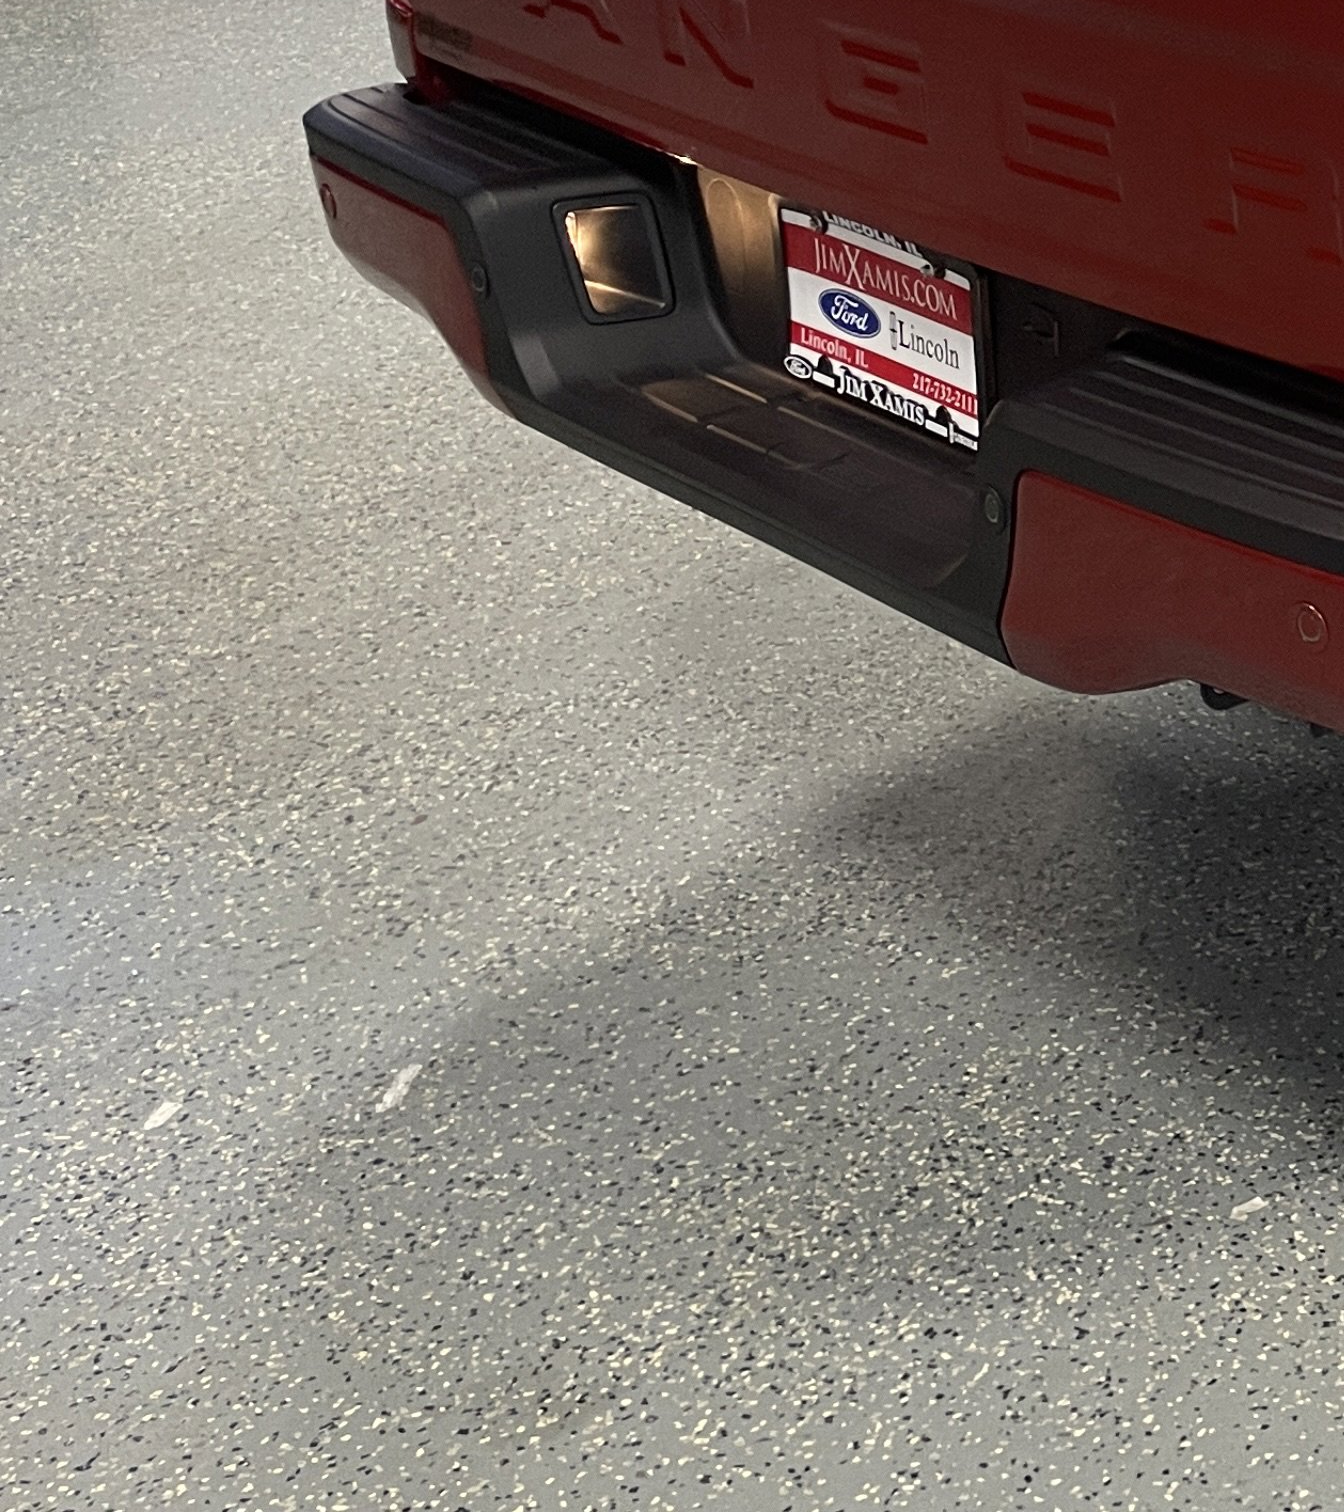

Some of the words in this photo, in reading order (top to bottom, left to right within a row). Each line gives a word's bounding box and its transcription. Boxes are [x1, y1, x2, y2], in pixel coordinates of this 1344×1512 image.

[814, 237, 958, 321] JIMXAMIS.COM
[830, 294, 869, 332] Ford
[854, 351, 869, 368] IL
[898, 320, 960, 370] Lincoln
[837, 370, 868, 402] JIM
[869, 382, 925, 426] XAMIS
[912, 372, 978, 415] 217-732-2111
